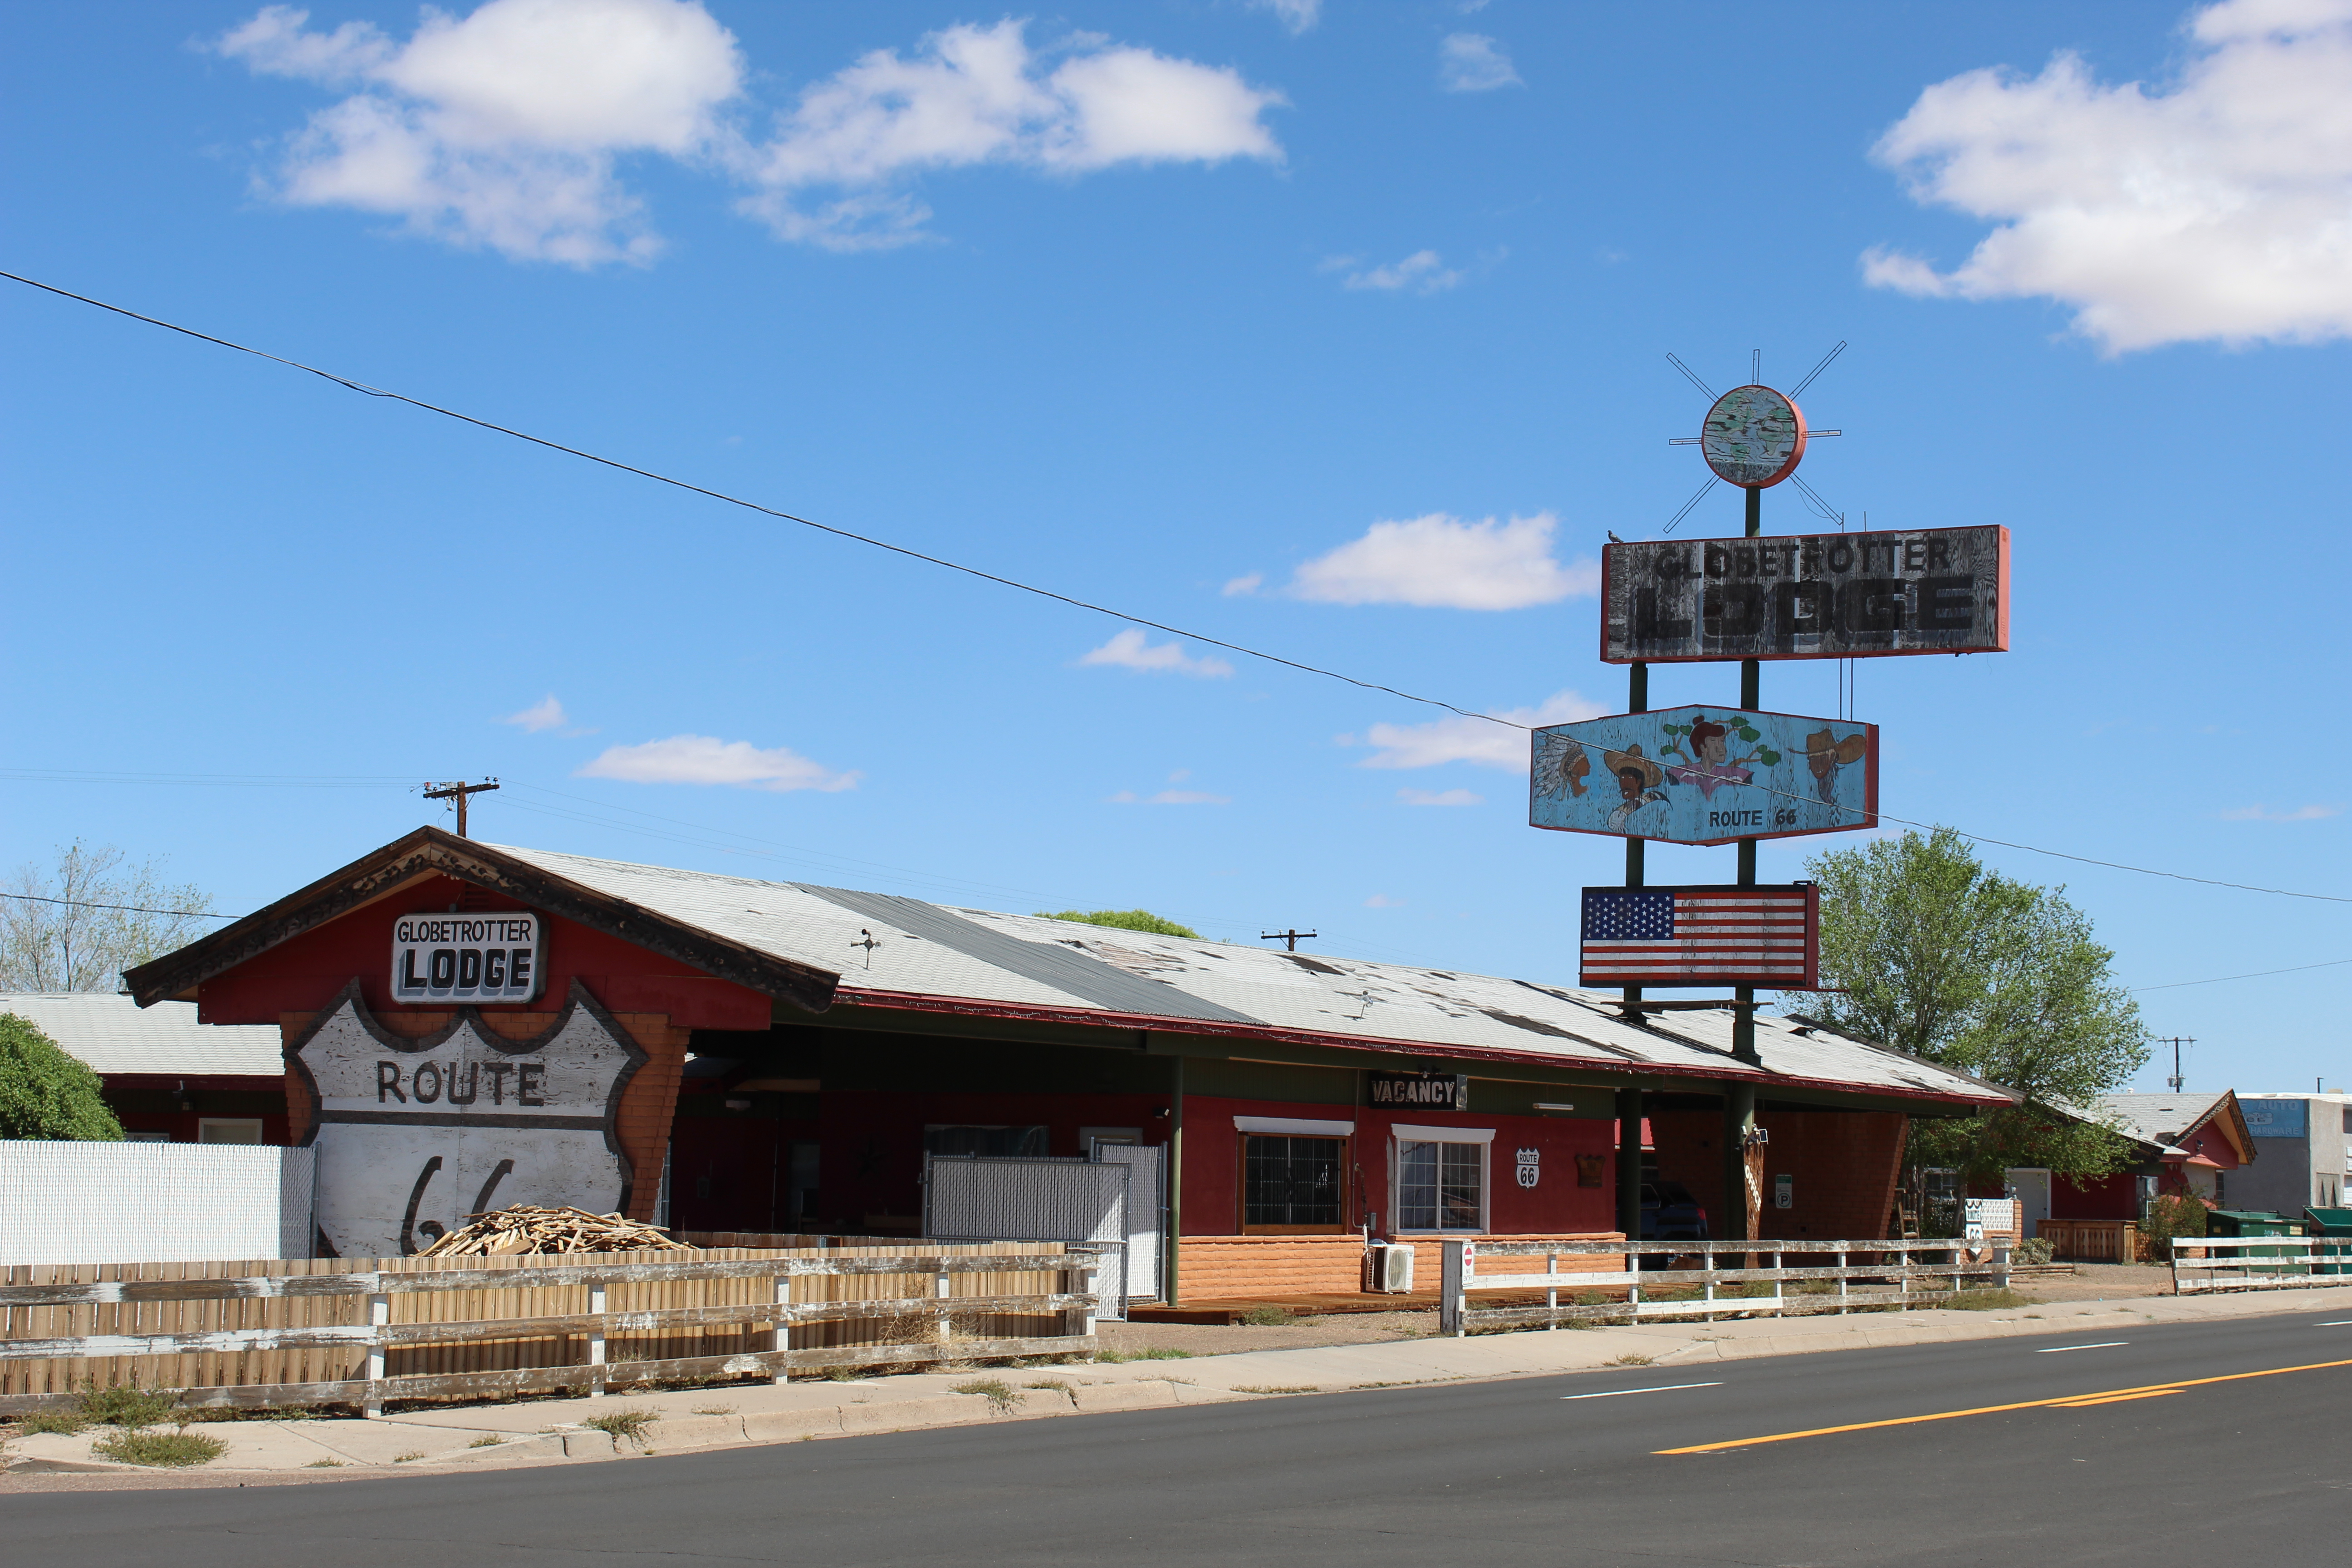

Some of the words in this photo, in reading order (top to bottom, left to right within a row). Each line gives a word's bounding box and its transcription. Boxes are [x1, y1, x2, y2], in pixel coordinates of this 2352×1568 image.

[1655, 537, 1950, 581] GLOBETROTTER
[1634, 576, 1974, 640] LODGE
[1710, 810, 1763, 827] ROUTE
[1775, 808, 1798, 826] 66
[397, 919, 531, 943] GLOBETROTTER
[401, 948, 532, 991] LODGE
[377, 1060, 546, 1107] ROUTE
[1372, 1080, 1455, 1103] VACANCY
[2257, 1100, 2299, 1110] AUTO
[1519, 1154, 1537, 1162] ROUTE
[1520, 1166, 1534, 1185] 66
[1745, 1165, 1761, 1212] OFFICE
[1967, 1210, 1980, 1220] ROUTE
